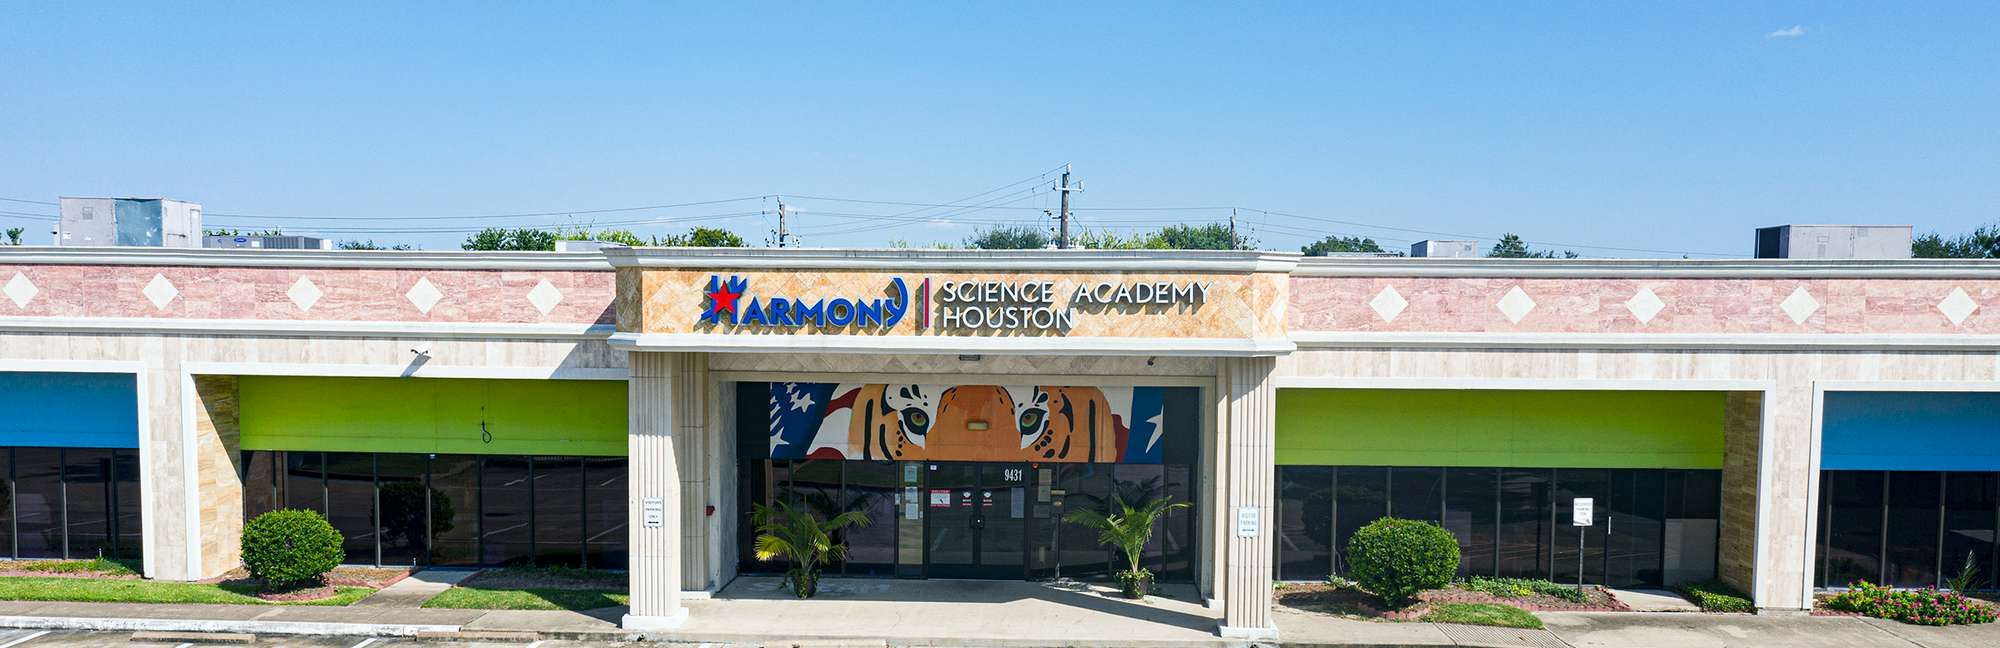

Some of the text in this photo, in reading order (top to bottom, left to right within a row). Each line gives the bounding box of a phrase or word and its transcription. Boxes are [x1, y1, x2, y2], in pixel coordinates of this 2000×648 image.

[942, 280, 1214, 304] SCIENCE ACADEMY
[942, 306, 1073, 329] HOUSTON
[1004, 468, 1023, 481] 9431
